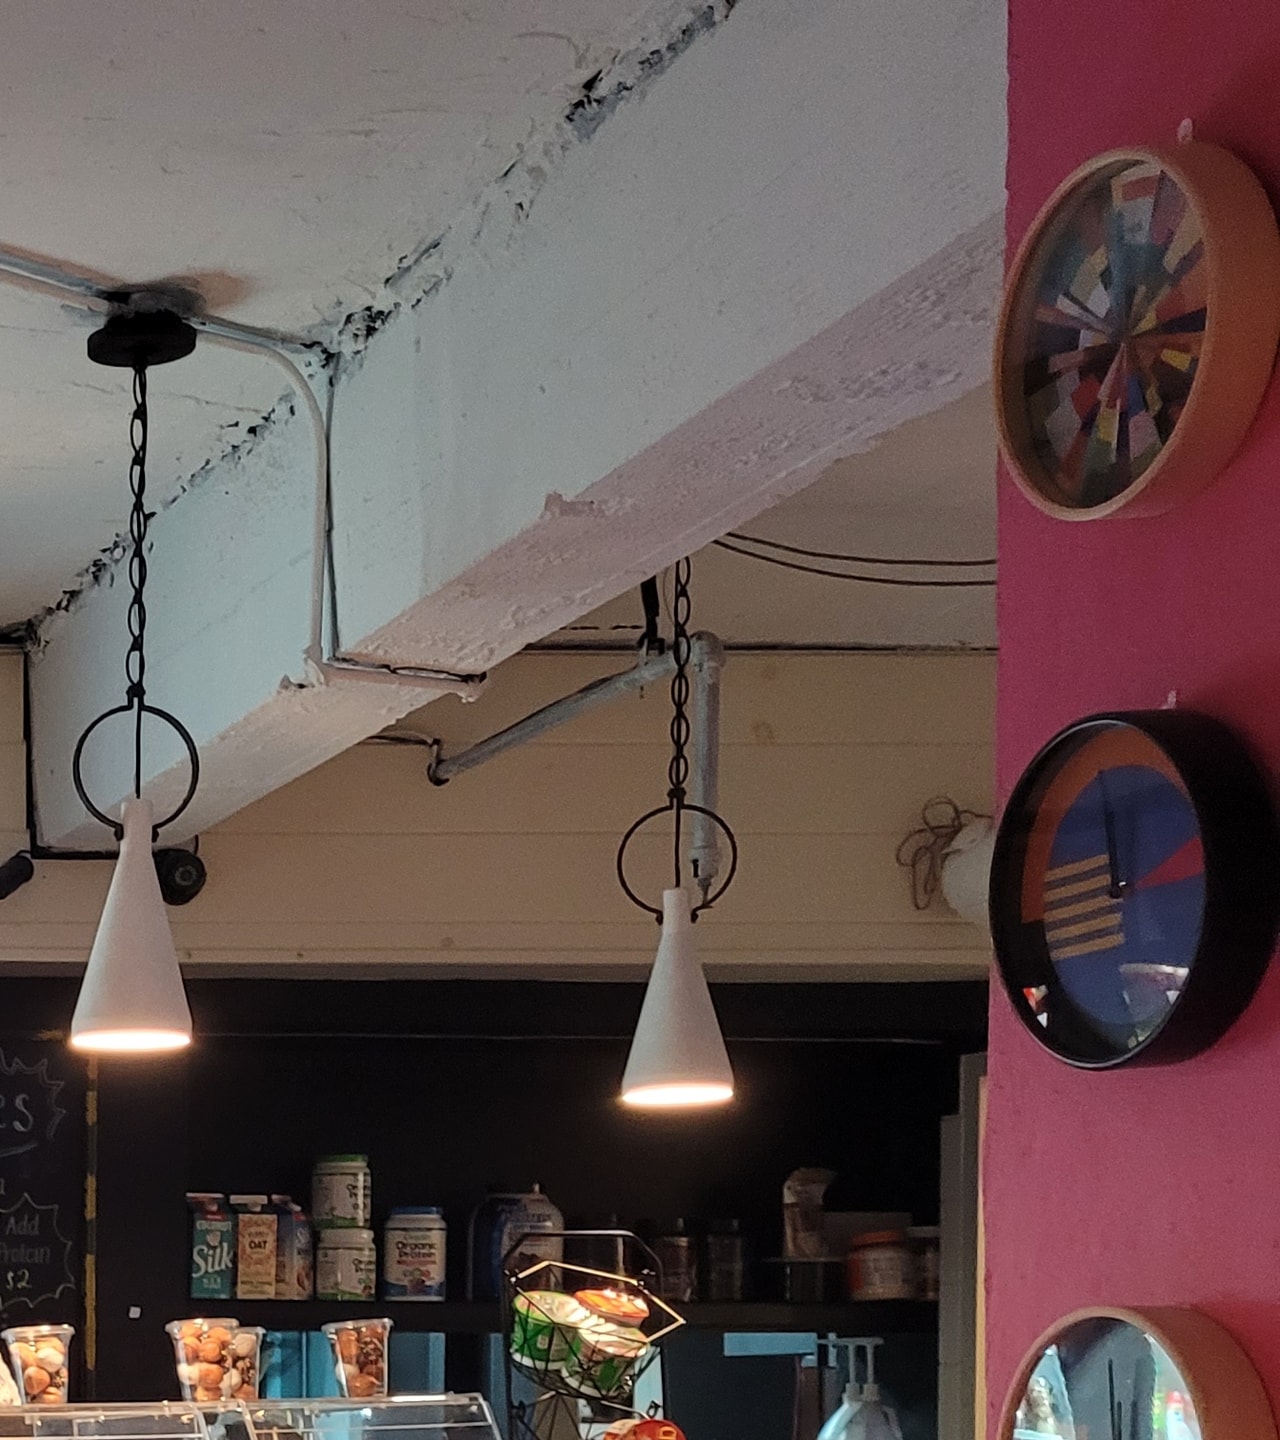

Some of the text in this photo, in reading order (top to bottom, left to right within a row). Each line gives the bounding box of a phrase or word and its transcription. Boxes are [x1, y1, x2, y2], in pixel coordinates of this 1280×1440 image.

[5, 1213, 41, 1236] Add
[248, 1240, 268, 1250] OAT
[191, 1242, 234, 1278] Silk
[5, 1268, 32, 1291] $2
